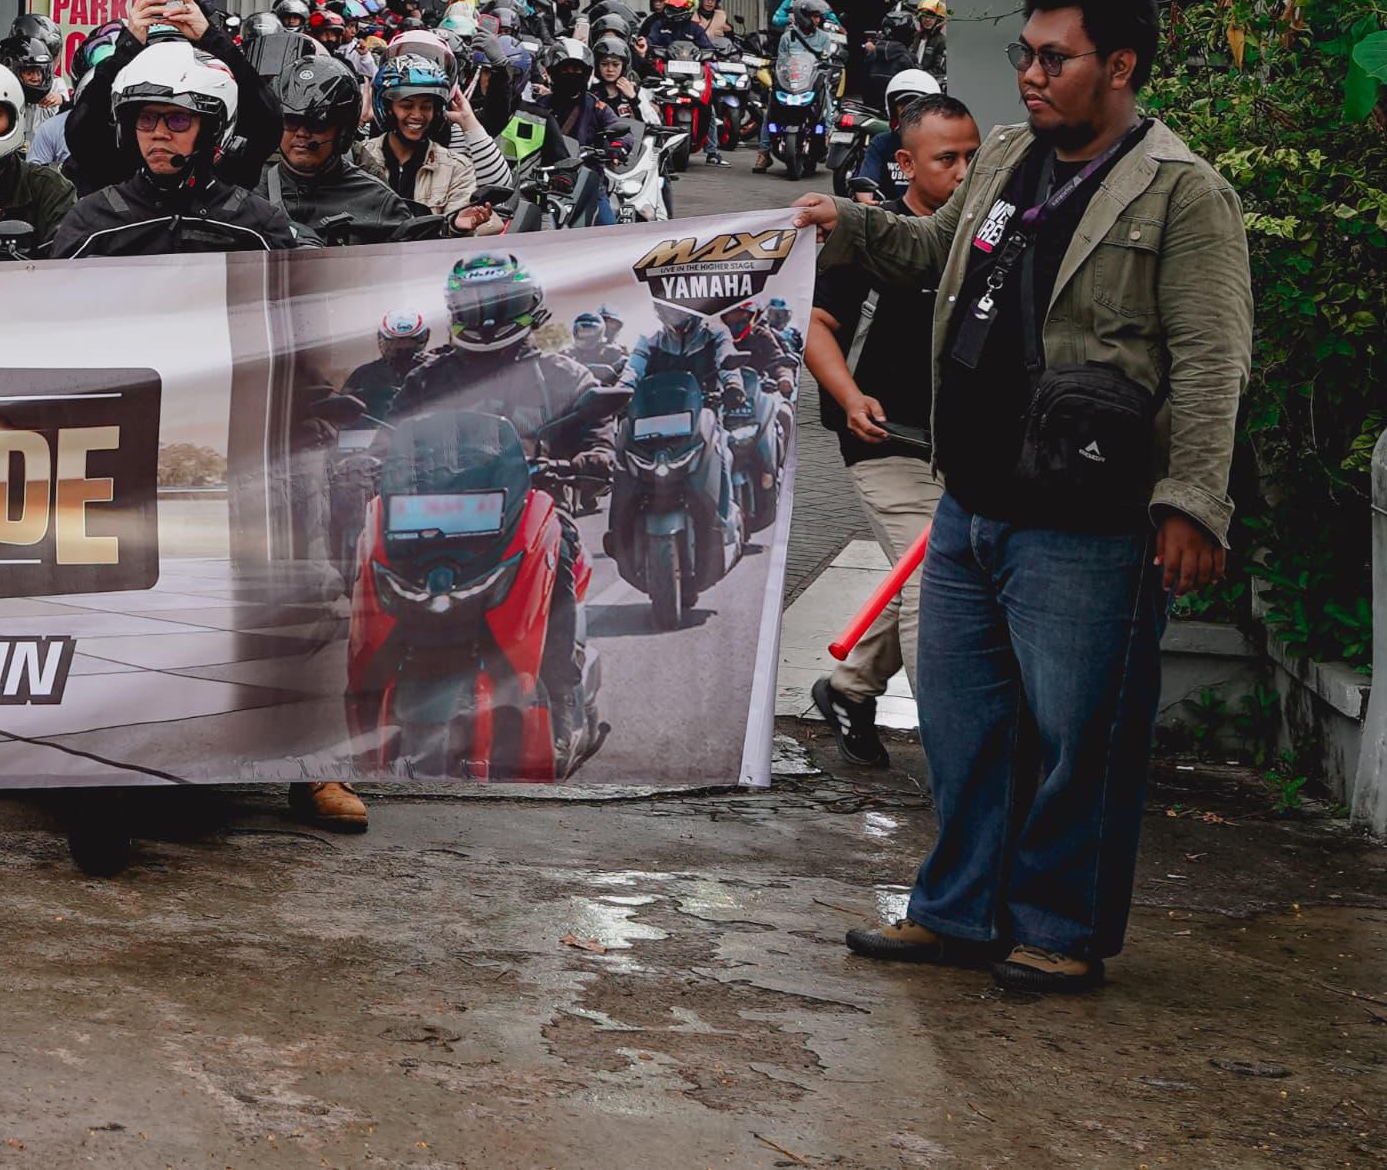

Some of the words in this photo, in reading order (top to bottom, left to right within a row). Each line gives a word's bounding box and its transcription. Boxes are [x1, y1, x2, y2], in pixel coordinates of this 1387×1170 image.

[633, 229, 798, 270] MAXI
[686, 264, 699, 272] THE
[700, 263, 730, 272] HIGHER
[731, 262, 755, 271] STAGE
[660, 274, 753, 300] YAMAHA
